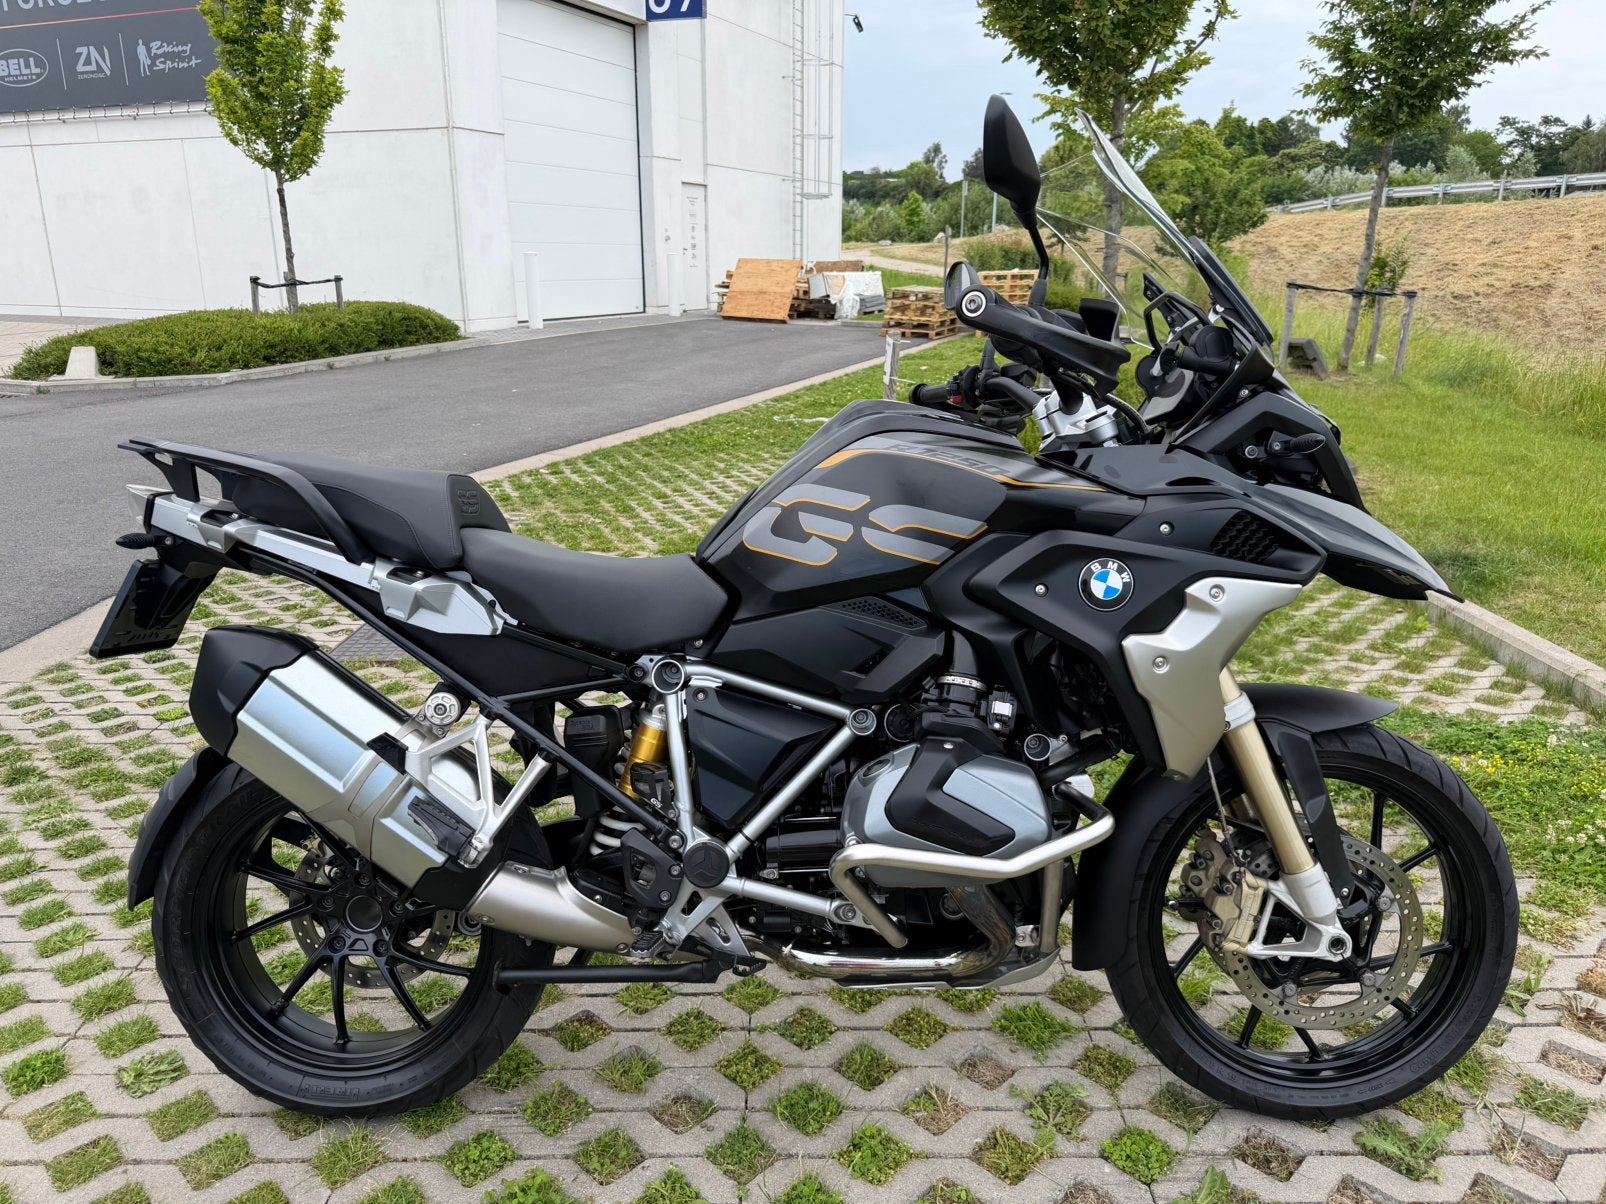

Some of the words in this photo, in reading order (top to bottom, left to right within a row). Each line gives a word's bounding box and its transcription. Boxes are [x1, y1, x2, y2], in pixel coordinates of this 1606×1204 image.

[150, 40, 191, 56] Racing
[0, 57, 41, 76] BELL
[153, 56, 202, 73] Spirit
[742, 483, 988, 566] GS
[1090, 560, 1131, 583] BMW
